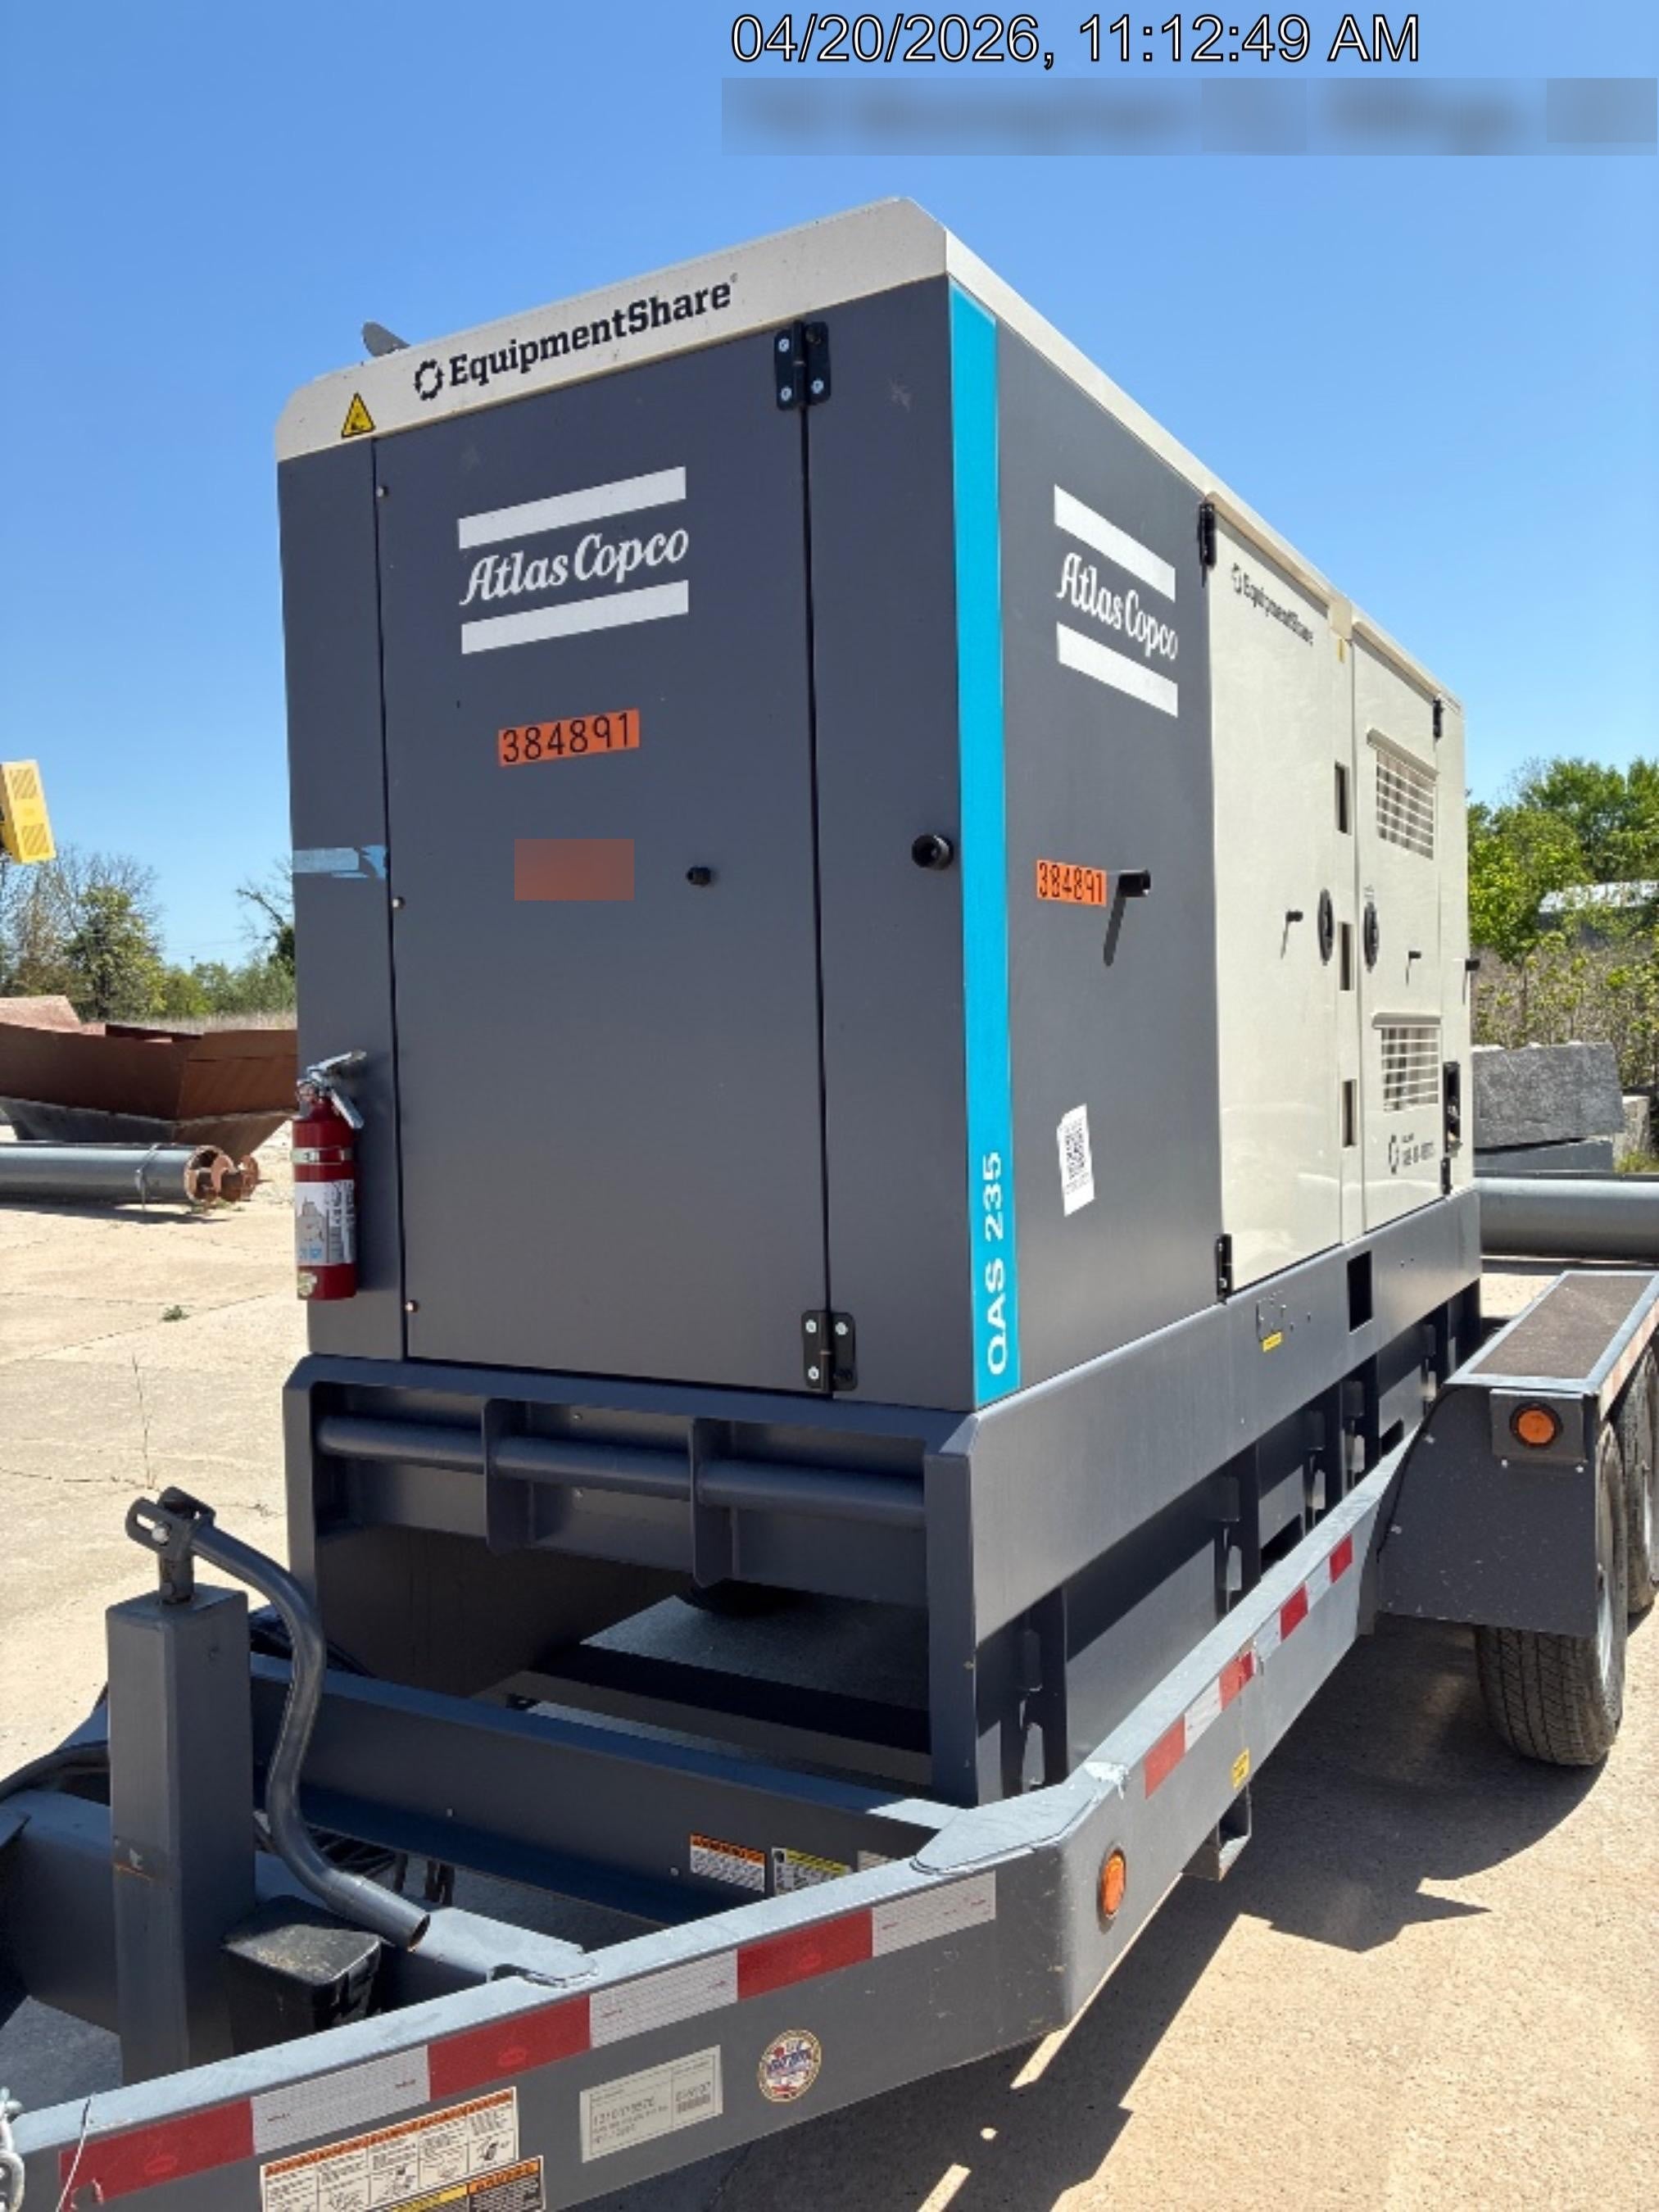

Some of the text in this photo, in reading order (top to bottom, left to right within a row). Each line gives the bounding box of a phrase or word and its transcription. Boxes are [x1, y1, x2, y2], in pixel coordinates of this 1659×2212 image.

[449, 282, 732, 387] EquipmentShare
[459, 528, 689, 606] Atlas Copco
[1055, 552, 1179, 661] Atlas Copco
[502, 712, 628, 763] 384891
[1038, 861, 1103, 904] 384891
[983, 1151, 1008, 1376] QAS 235
